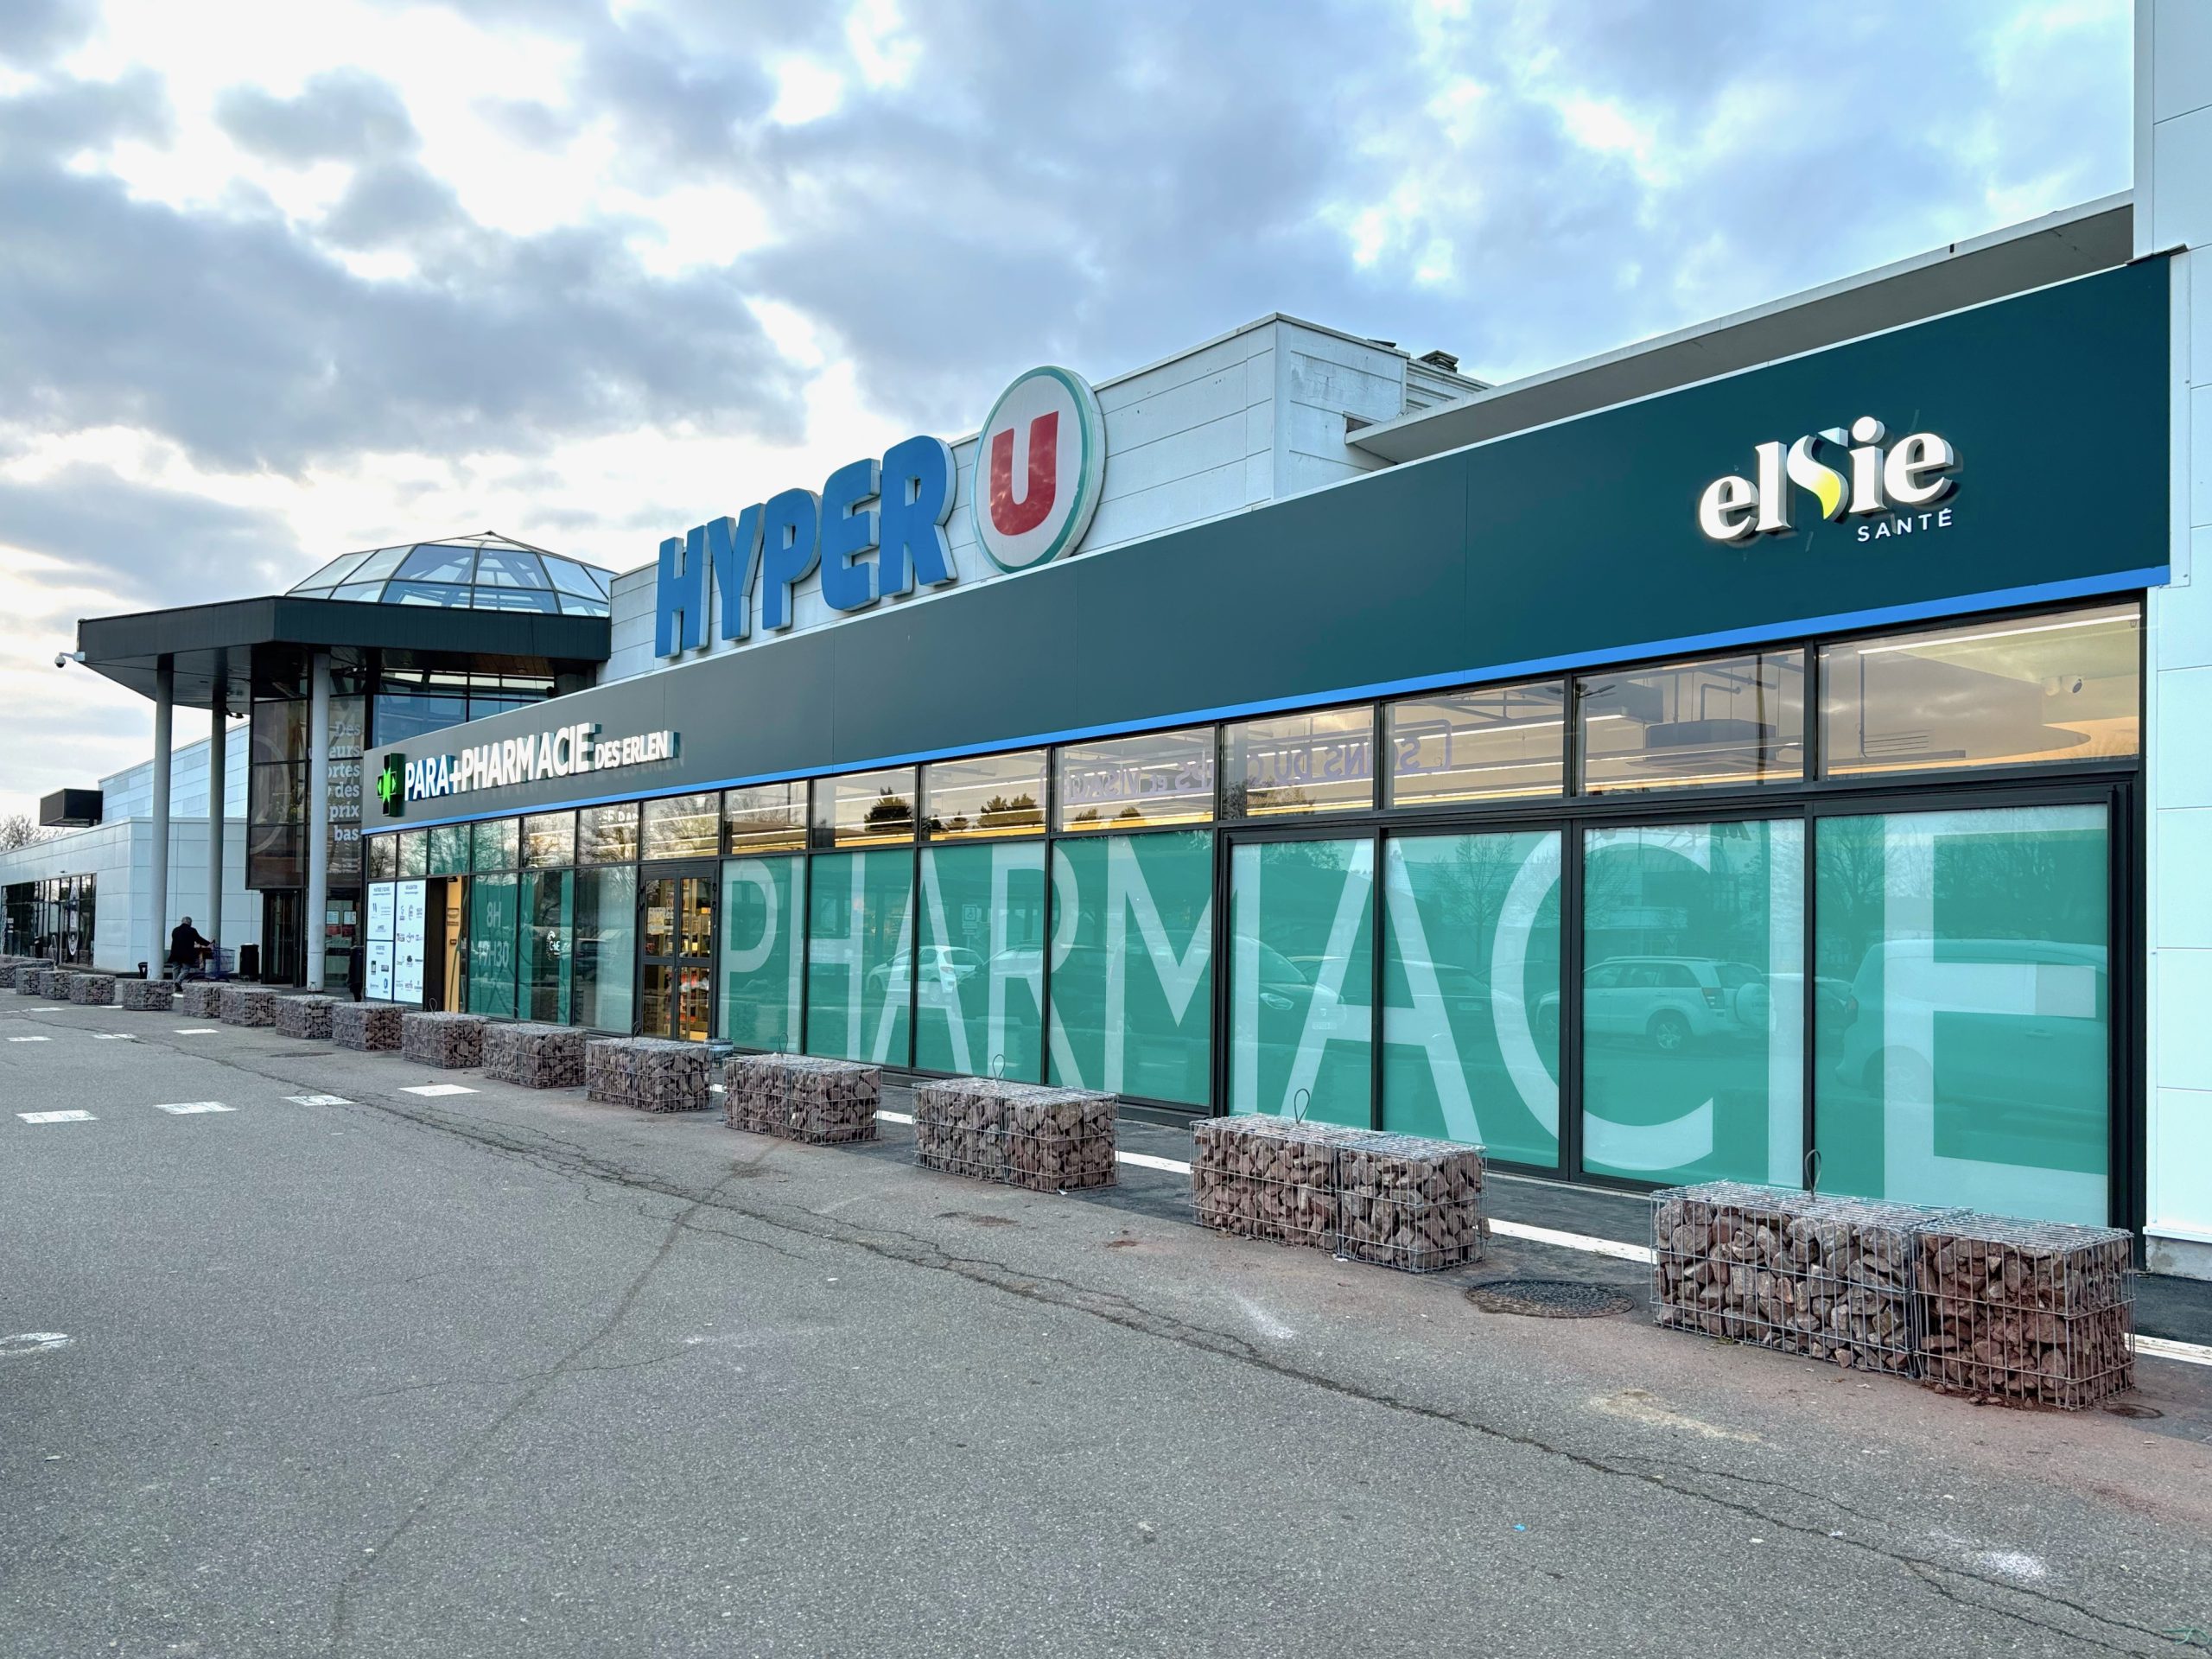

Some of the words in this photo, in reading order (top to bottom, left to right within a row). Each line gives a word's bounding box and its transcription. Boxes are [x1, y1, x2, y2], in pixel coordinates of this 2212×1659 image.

[655, 435, 957, 659] HYPER
[990, 410, 1059, 537] U
[1857, 508, 1954, 543] SANTÉ
[334, 721, 361, 737] Des
[594, 741, 620, 770] DES
[622, 730, 674, 764] ERLEN
[334, 781, 360, 798] des
[329, 801, 360, 822] prix
[334, 825, 360, 842] bas
[486, 901, 502, 928] 8H
[719, 804, 2108, 1227] PHARMACIE
